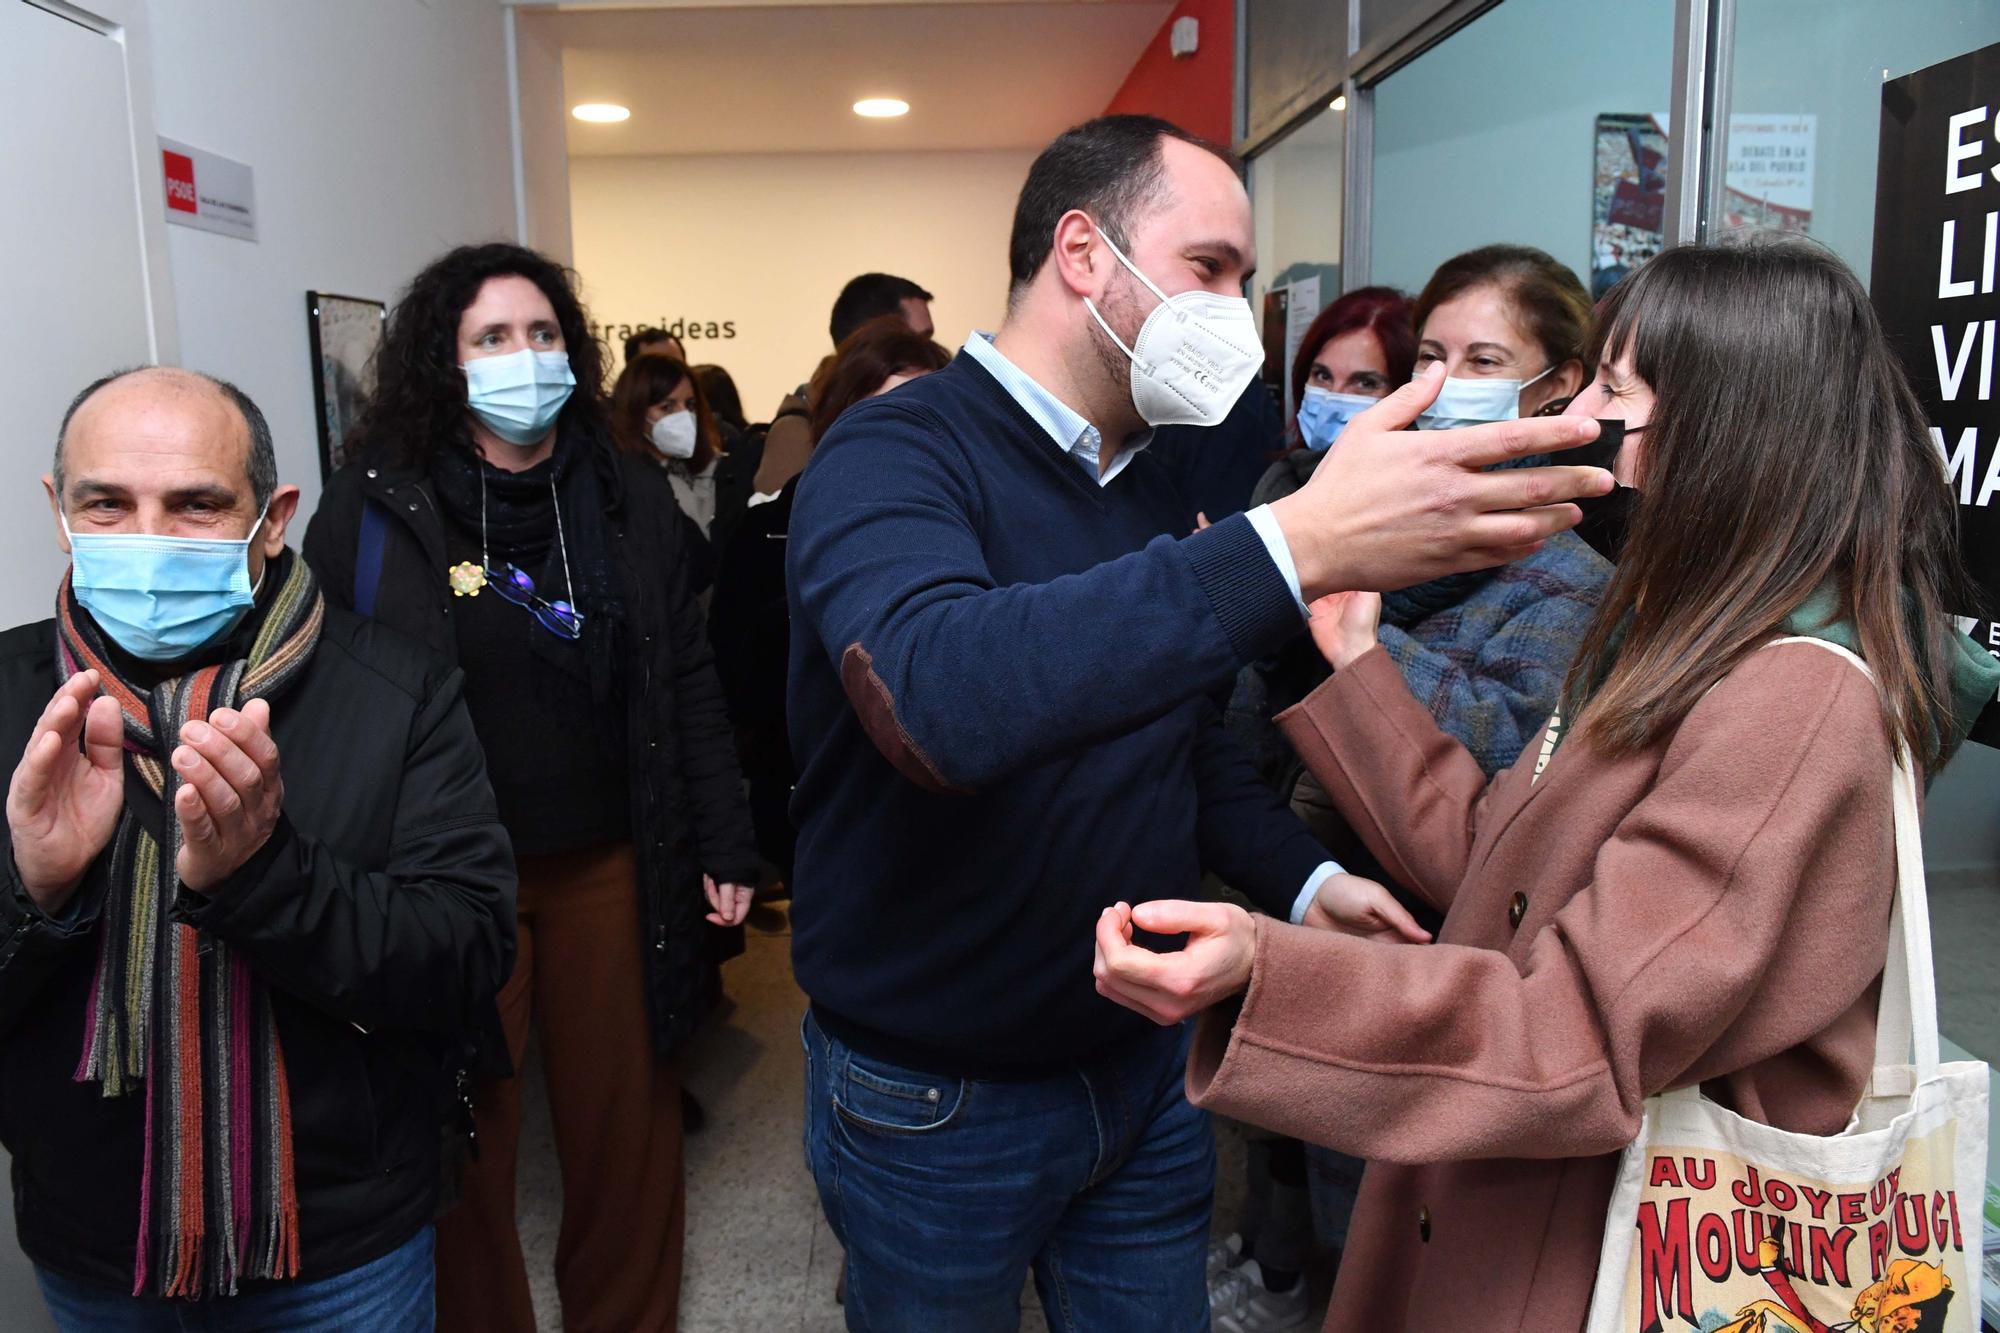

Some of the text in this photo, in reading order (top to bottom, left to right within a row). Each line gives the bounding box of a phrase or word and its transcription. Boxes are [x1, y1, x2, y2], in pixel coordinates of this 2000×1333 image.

[1945, 105, 2000, 195] E
[167, 177, 195, 202] PSOE
[661, 317, 736, 340] ideas
[1931, 320, 1997, 401] VI
[1650, 1156, 1902, 1224] AU JOYEUX
[1868, 1188, 1963, 1282] RUG
